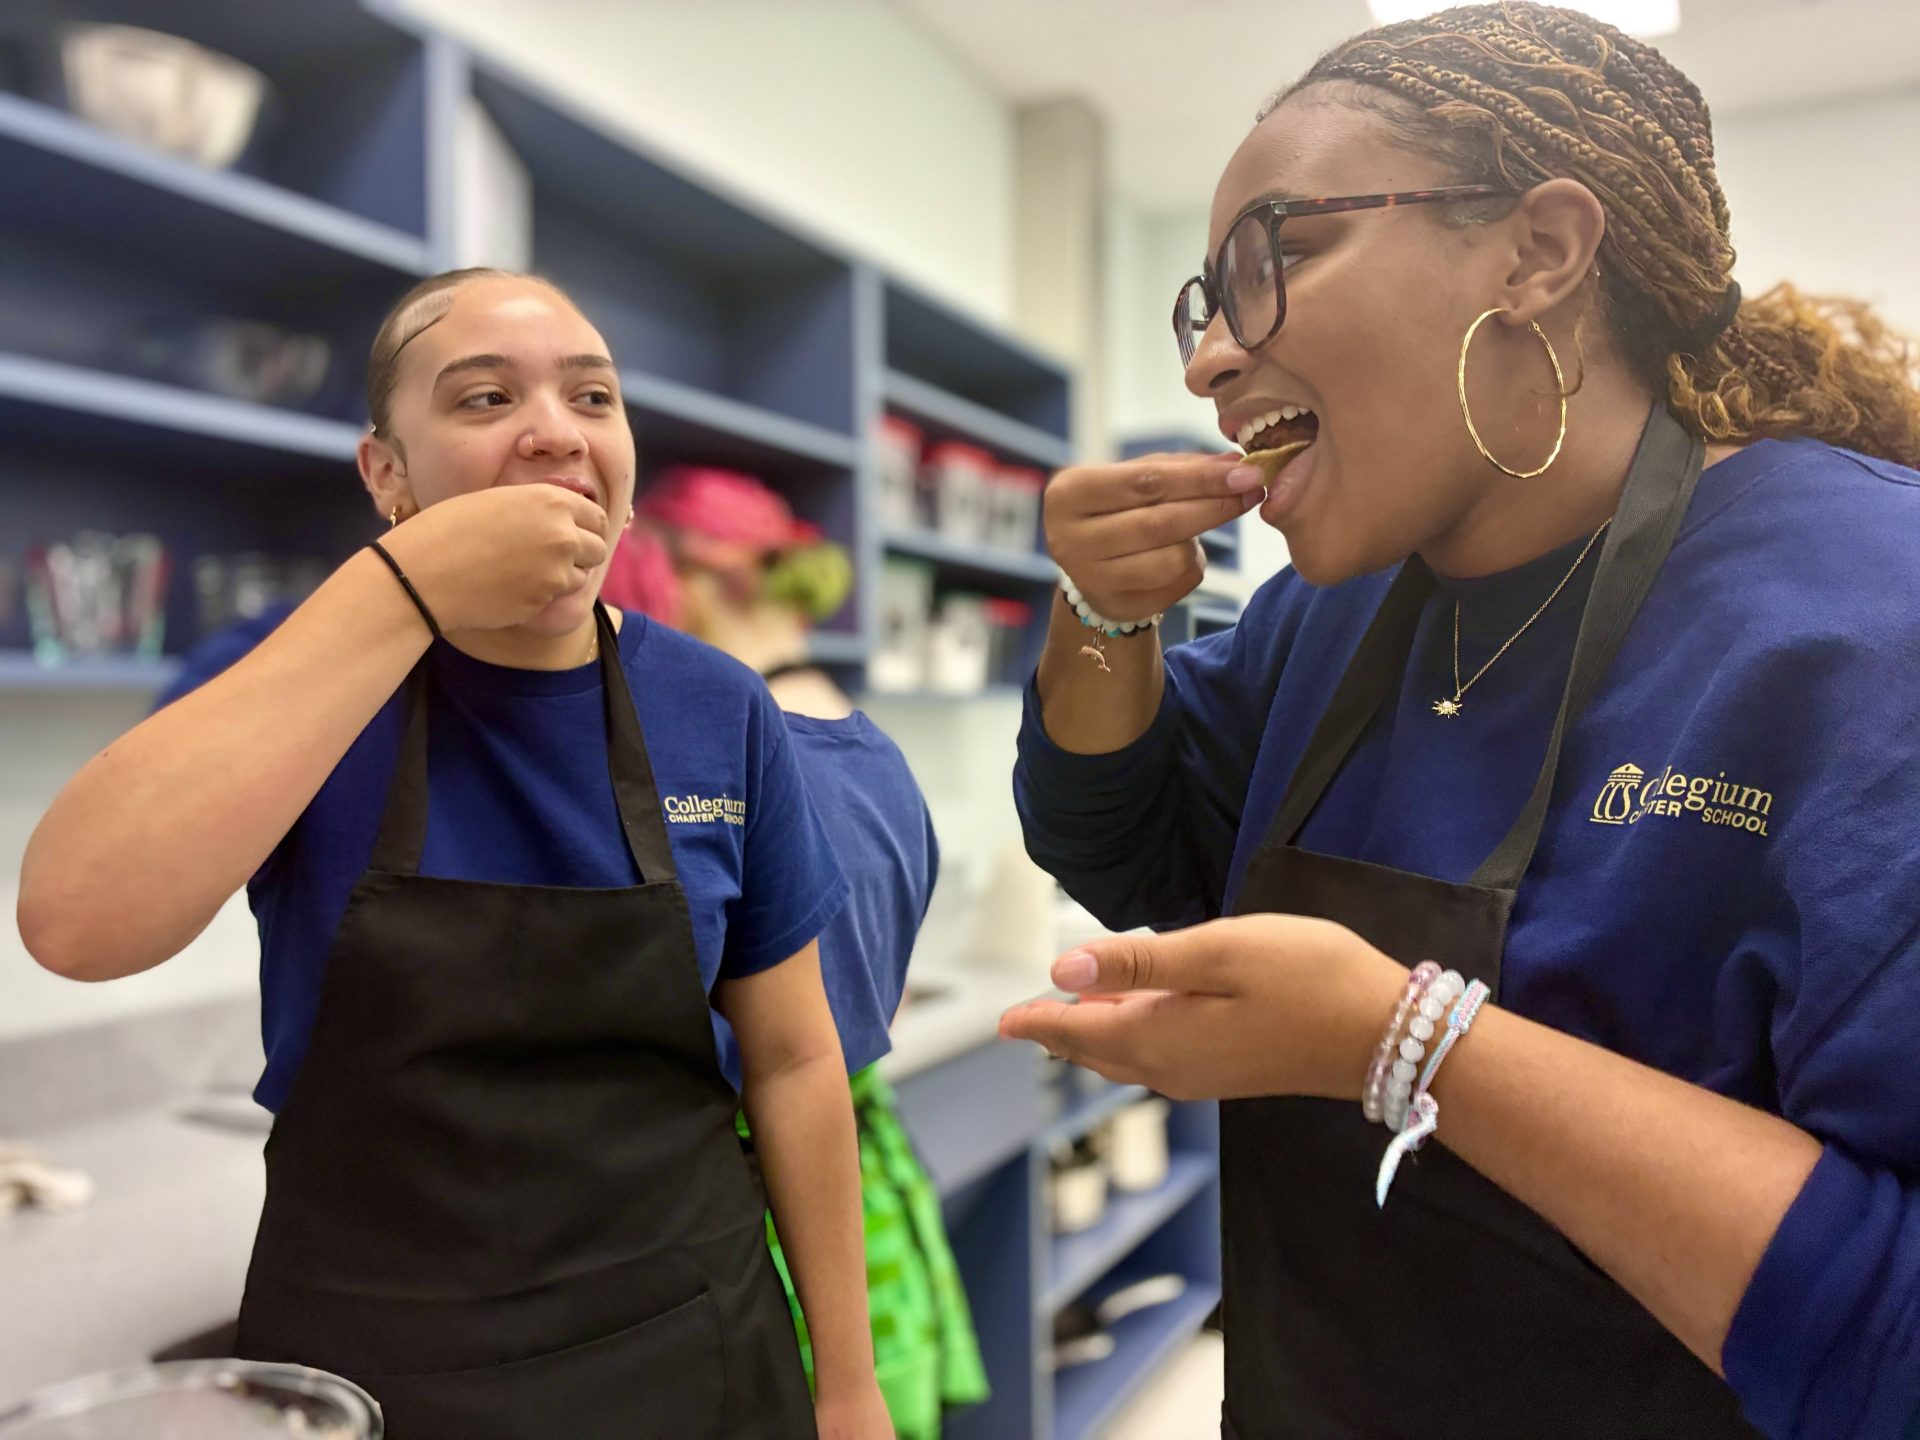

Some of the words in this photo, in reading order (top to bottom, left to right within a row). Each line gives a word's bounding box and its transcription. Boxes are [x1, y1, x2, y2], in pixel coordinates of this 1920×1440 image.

[664, 793, 745, 817] Collegium
[1640, 765, 1774, 816] Clegium
[668, 813, 715, 823] CHARTER
[723, 813, 745, 826] SOO
[1629, 800, 1682, 825] CTER
[1702, 808, 1768, 836] SCHOOL
